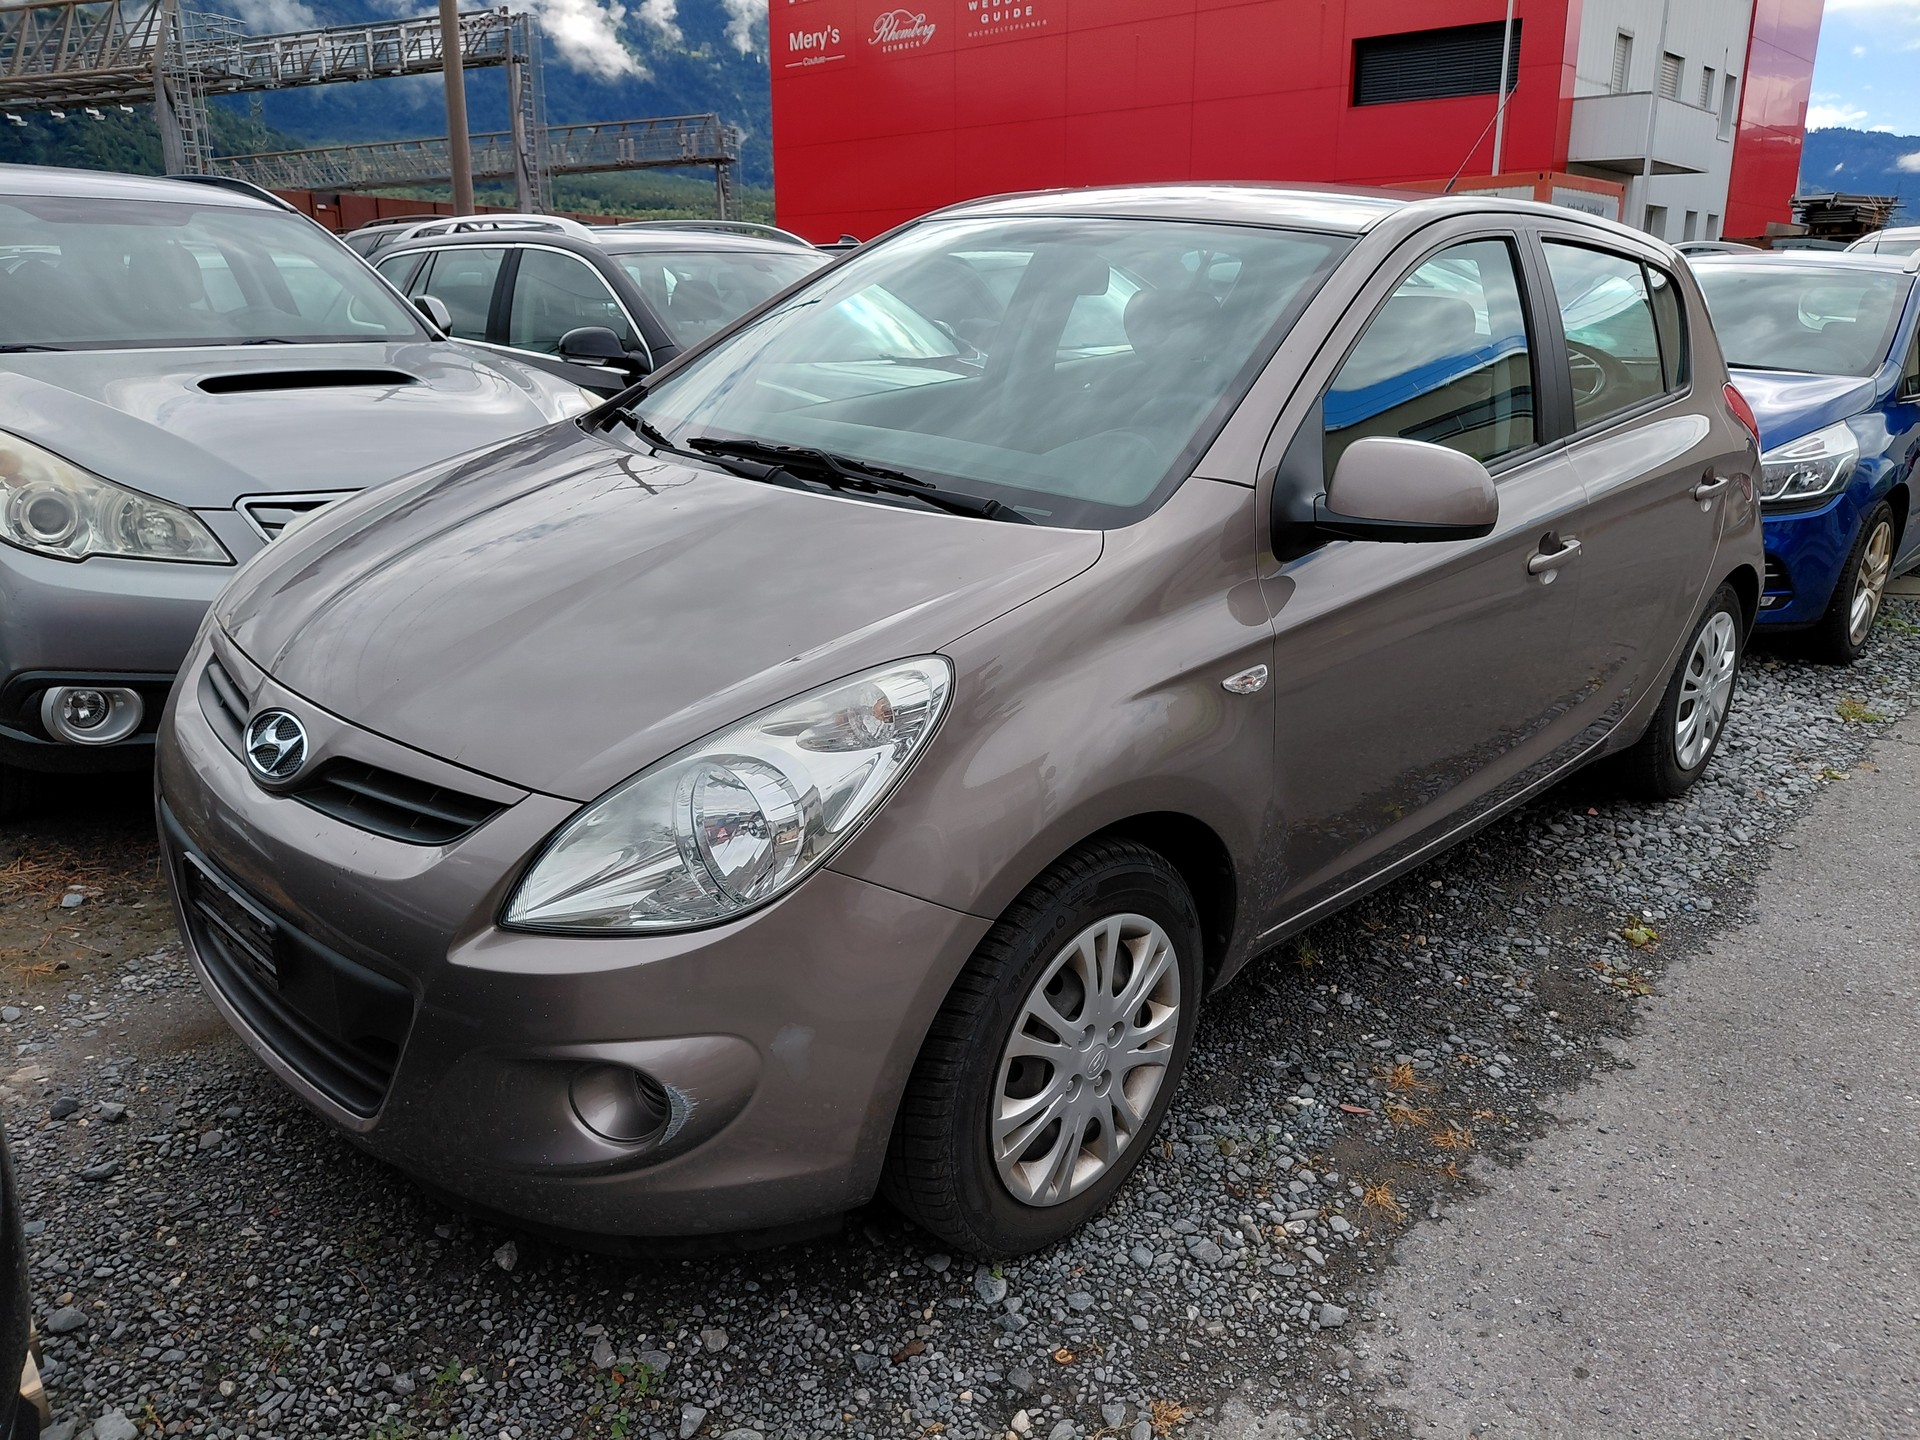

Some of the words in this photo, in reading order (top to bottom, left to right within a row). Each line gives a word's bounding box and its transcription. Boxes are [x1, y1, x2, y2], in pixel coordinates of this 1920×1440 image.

[868, 9, 936, 45] Rhomberg
[981, 5, 1033, 24] GUIDE
[789, 24, 840, 51] Mery's
